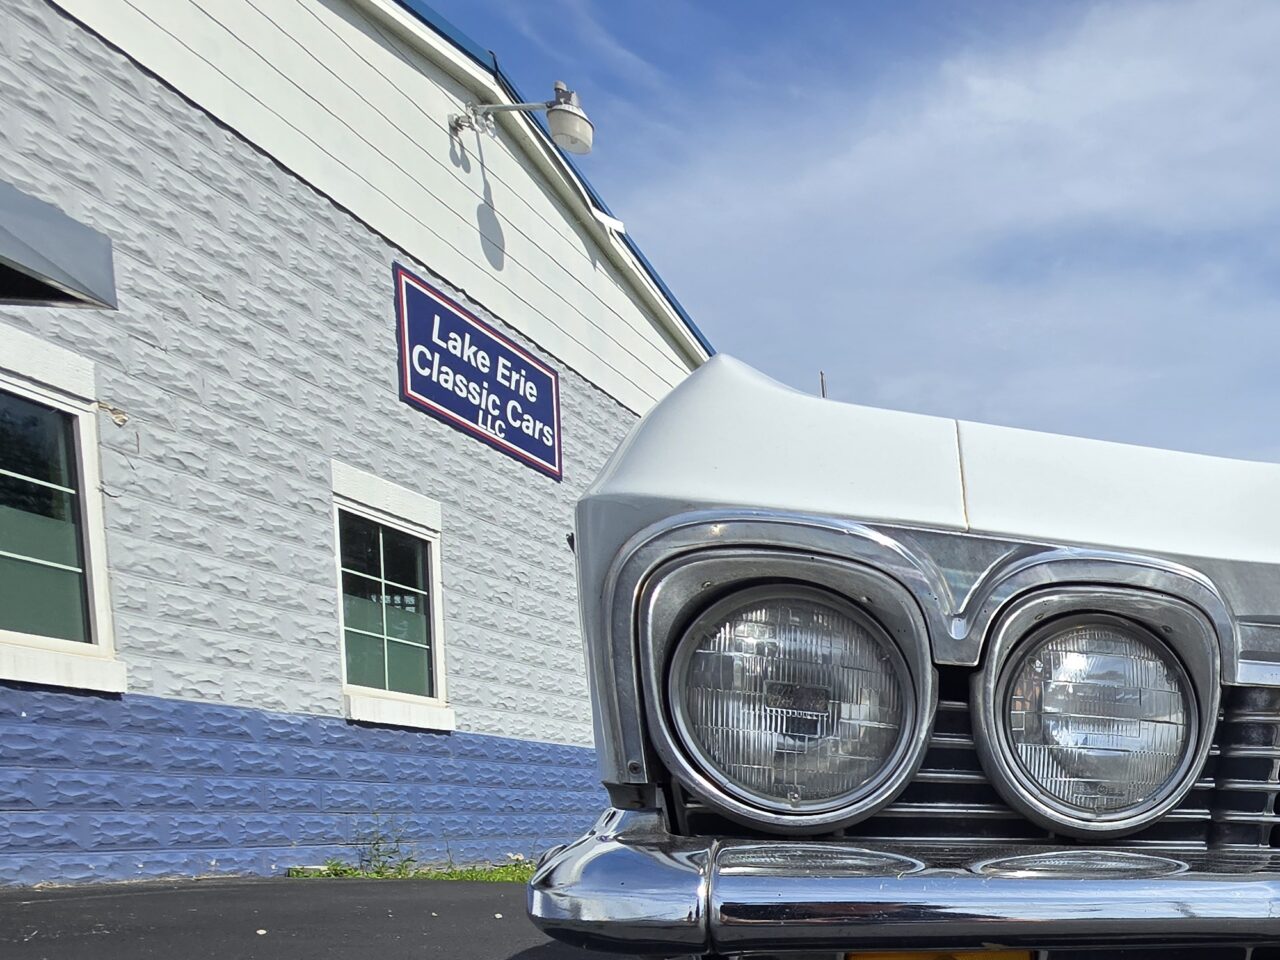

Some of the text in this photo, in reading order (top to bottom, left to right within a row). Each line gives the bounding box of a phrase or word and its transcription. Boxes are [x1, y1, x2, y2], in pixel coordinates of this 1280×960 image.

[412, 344, 553, 447] Classic Cars
[432, 314, 538, 402] Lake Erie
[477, 410, 506, 439] LLC
